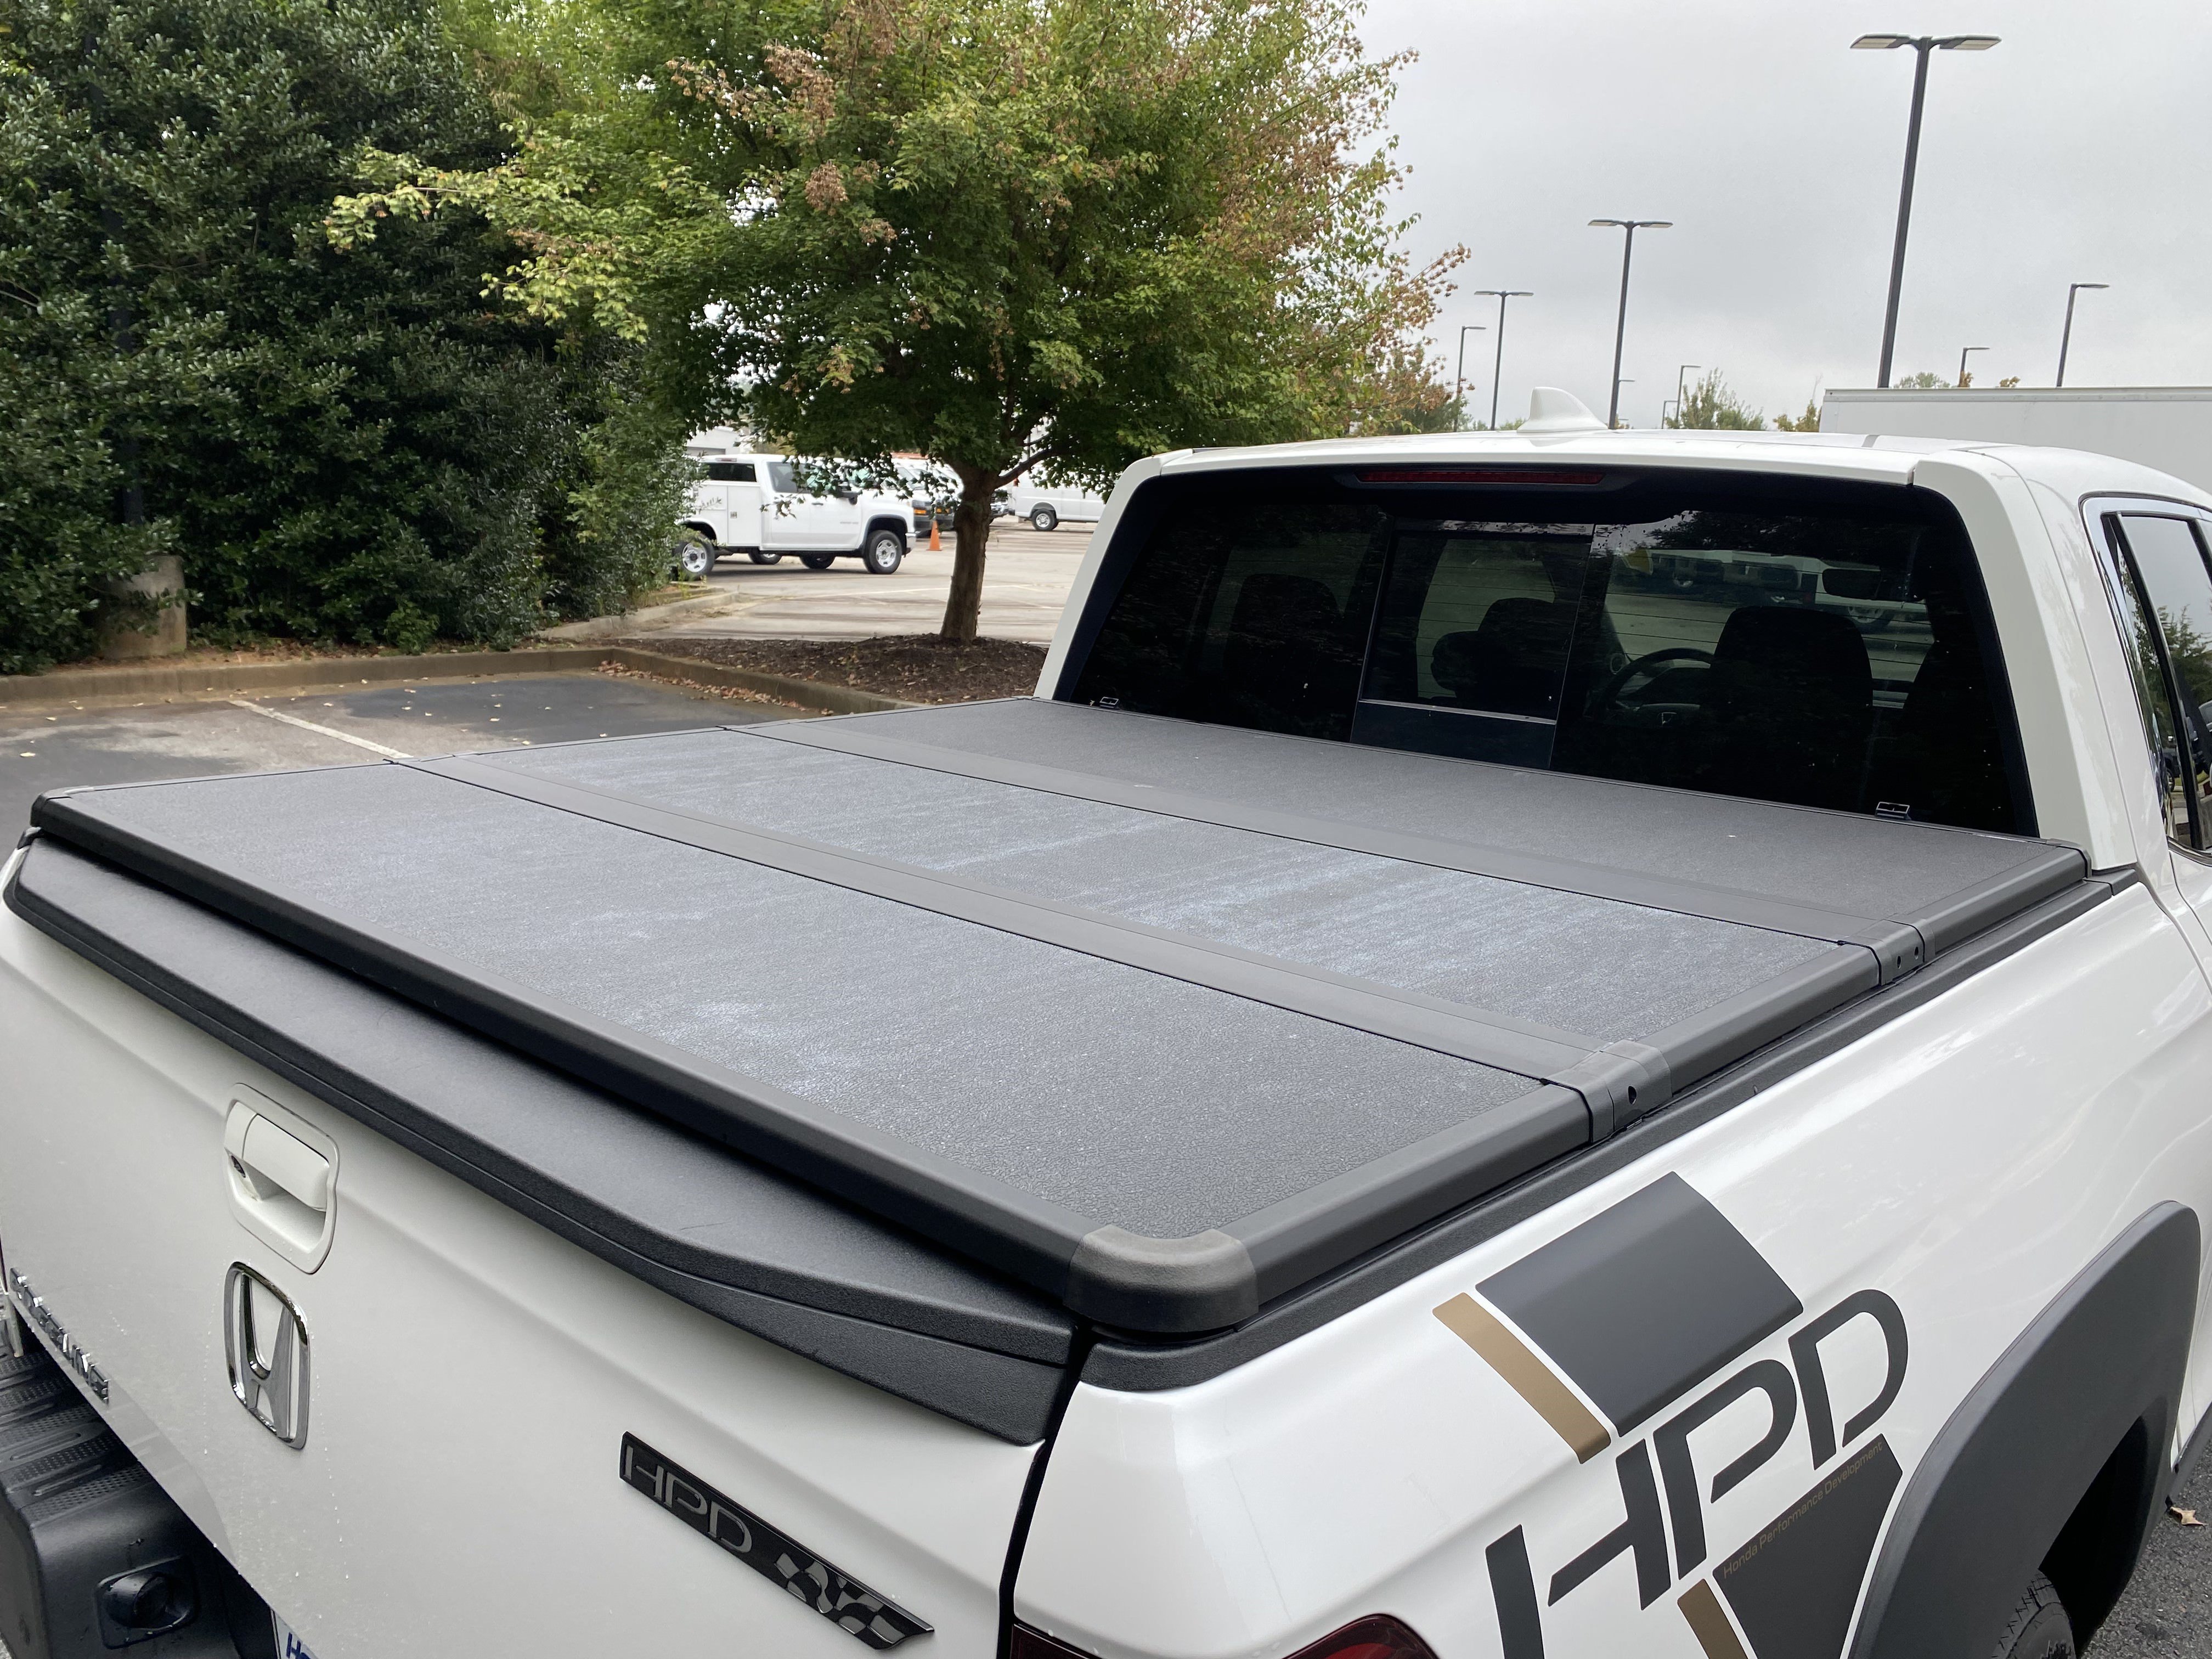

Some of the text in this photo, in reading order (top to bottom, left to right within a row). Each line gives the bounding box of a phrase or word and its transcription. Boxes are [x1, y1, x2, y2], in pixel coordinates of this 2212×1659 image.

[624, 1446, 753, 1553] HPD
[1486, 1289, 1908, 1659] HPD
[1723, 1441, 1882, 1579] Honda Performance Development
